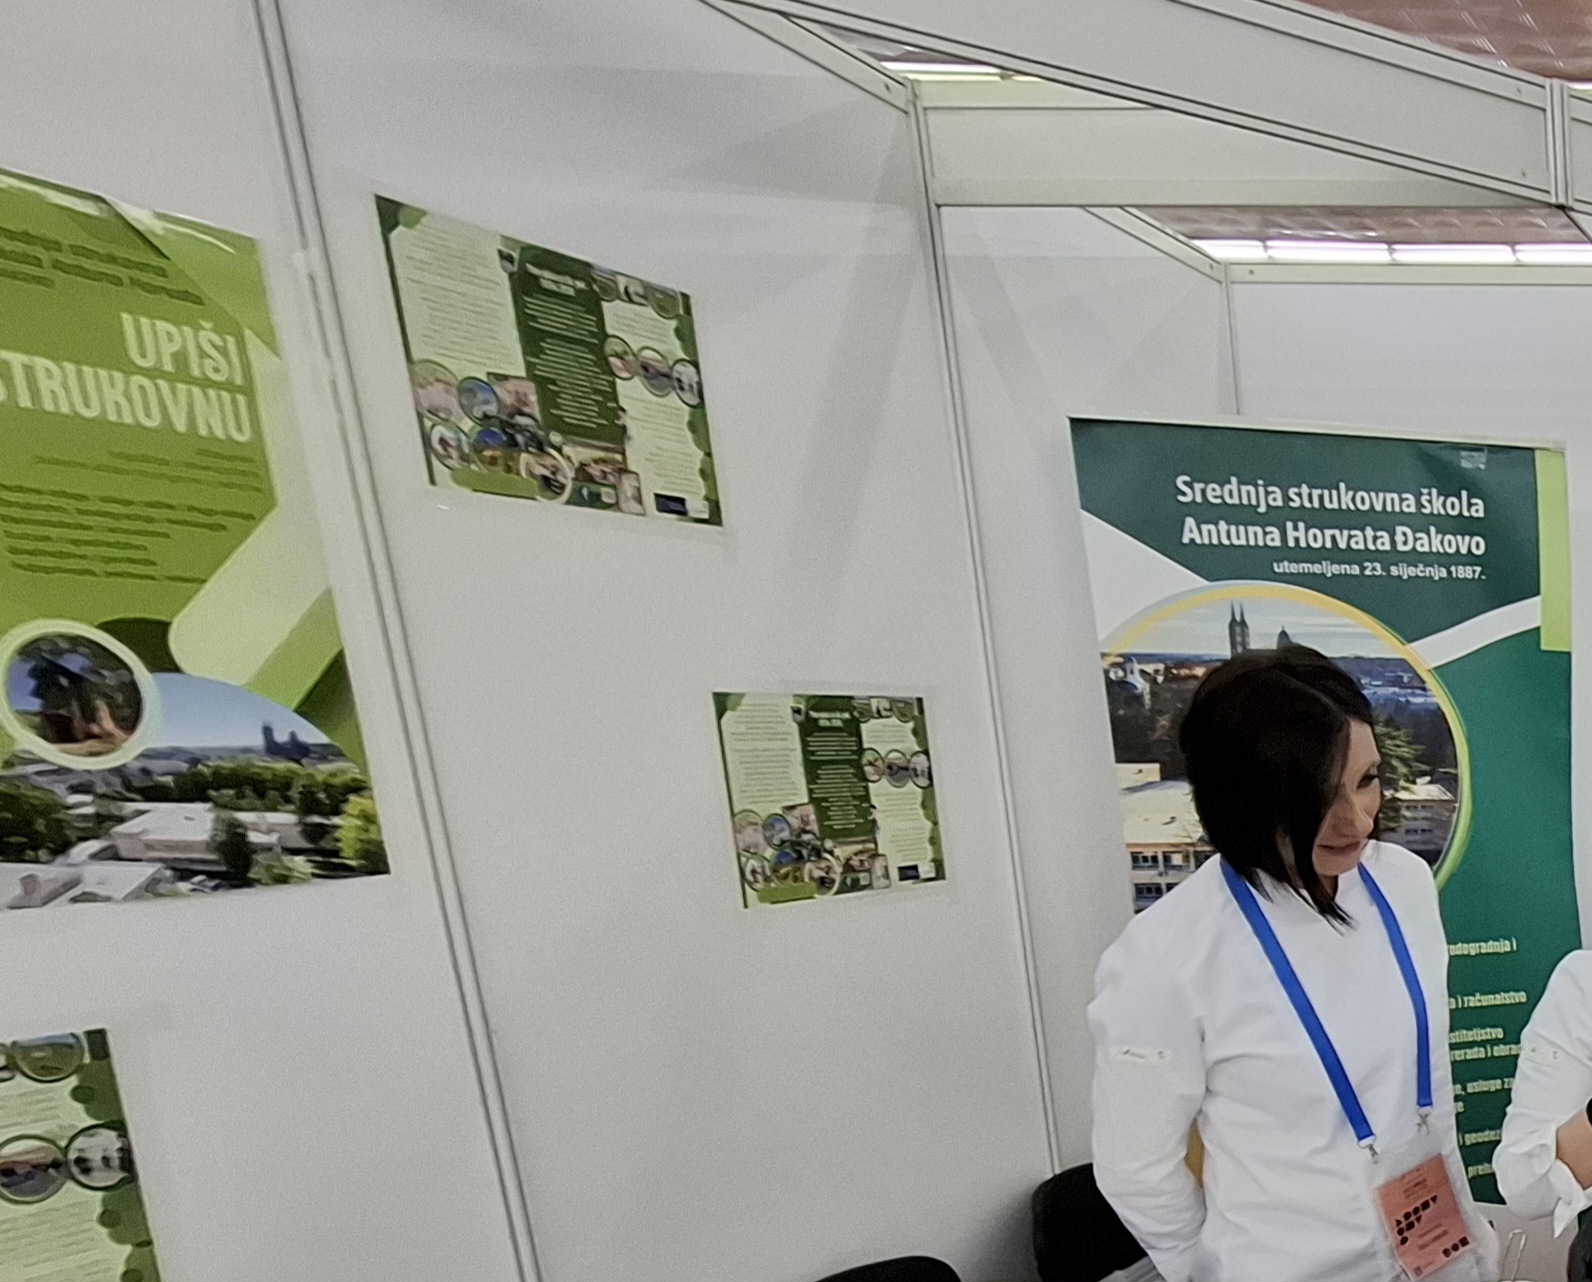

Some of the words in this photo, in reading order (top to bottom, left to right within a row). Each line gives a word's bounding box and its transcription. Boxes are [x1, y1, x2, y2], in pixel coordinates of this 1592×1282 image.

[120, 311, 245, 386] UPIŠI
[0, 350, 253, 444] TRUKOVNU
[1175, 475, 1283, 514] Srednja
[1287, 482, 1417, 513] strukovna
[1420, 488, 1486, 519] škola
[1181, 516, 1282, 548] Antuna
[1286, 521, 1391, 551] Horvata
[1394, 525, 1487, 556] Đakovo
[1273, 560, 1360, 578] utemeljena
[1363, 562, 1387, 576] 23.
[1389, 561, 1448, 580] siječnja
[1449, 565, 1487, 580] 1887.
